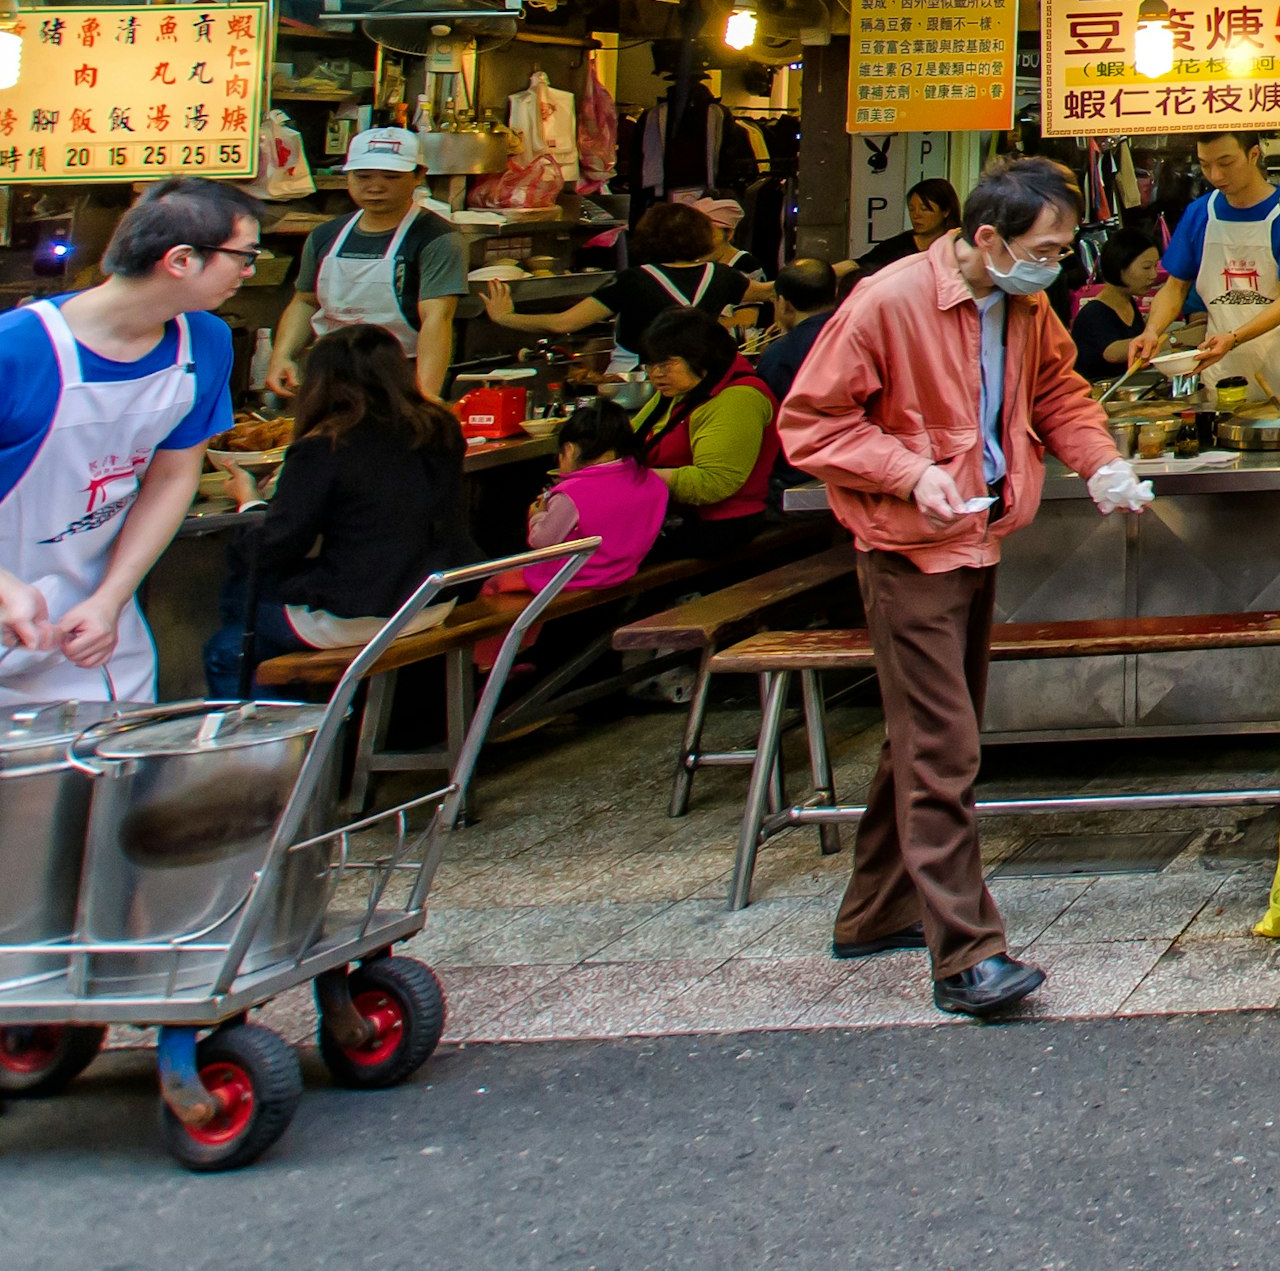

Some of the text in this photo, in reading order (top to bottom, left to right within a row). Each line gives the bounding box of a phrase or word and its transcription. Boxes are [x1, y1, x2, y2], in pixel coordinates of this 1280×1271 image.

[66, 148, 90, 166] 20
[109, 147, 127, 165] 15
[143, 146, 167, 165] 25
[182, 146, 205, 164] 25
[219, 145, 242, 163] 55
